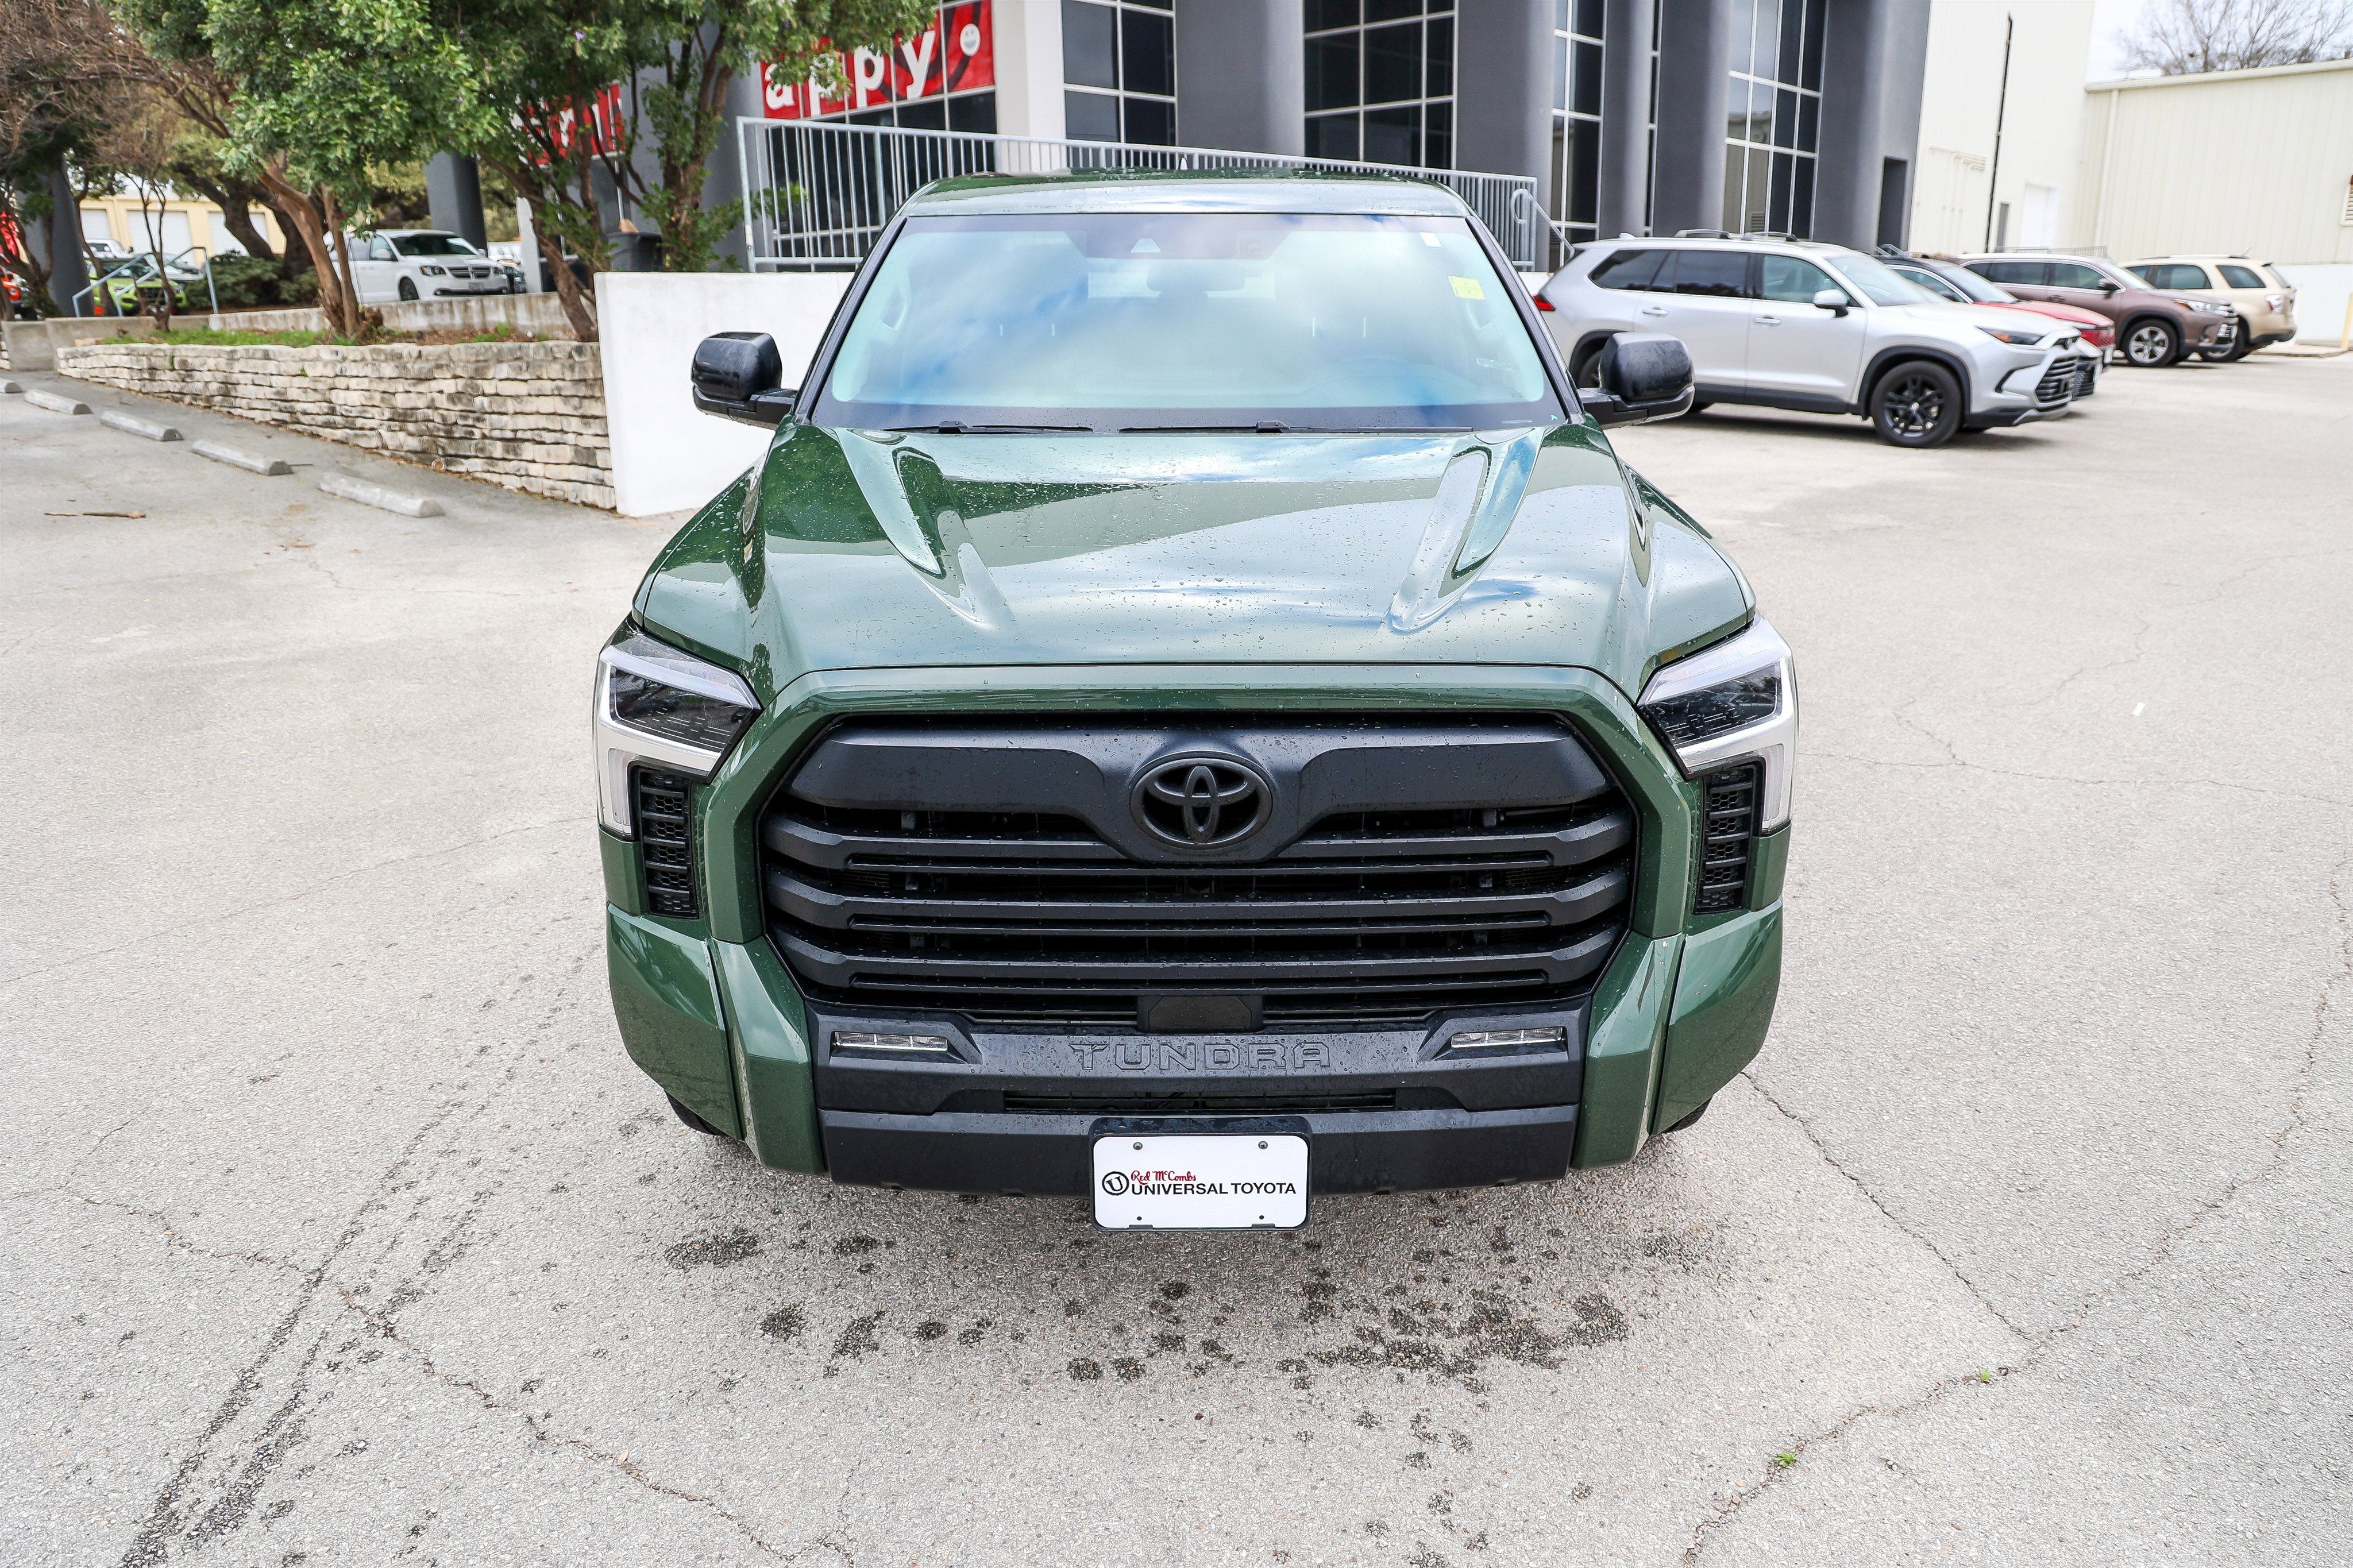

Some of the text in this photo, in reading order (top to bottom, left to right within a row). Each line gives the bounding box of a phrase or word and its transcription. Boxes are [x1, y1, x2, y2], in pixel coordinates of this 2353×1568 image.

[1069, 1041, 1330, 1071] TUNDRA
[1131, 1170, 1196, 1185] Red McCombs
[1131, 1182, 1297, 1195] UNIVERSAL TOYOTA
